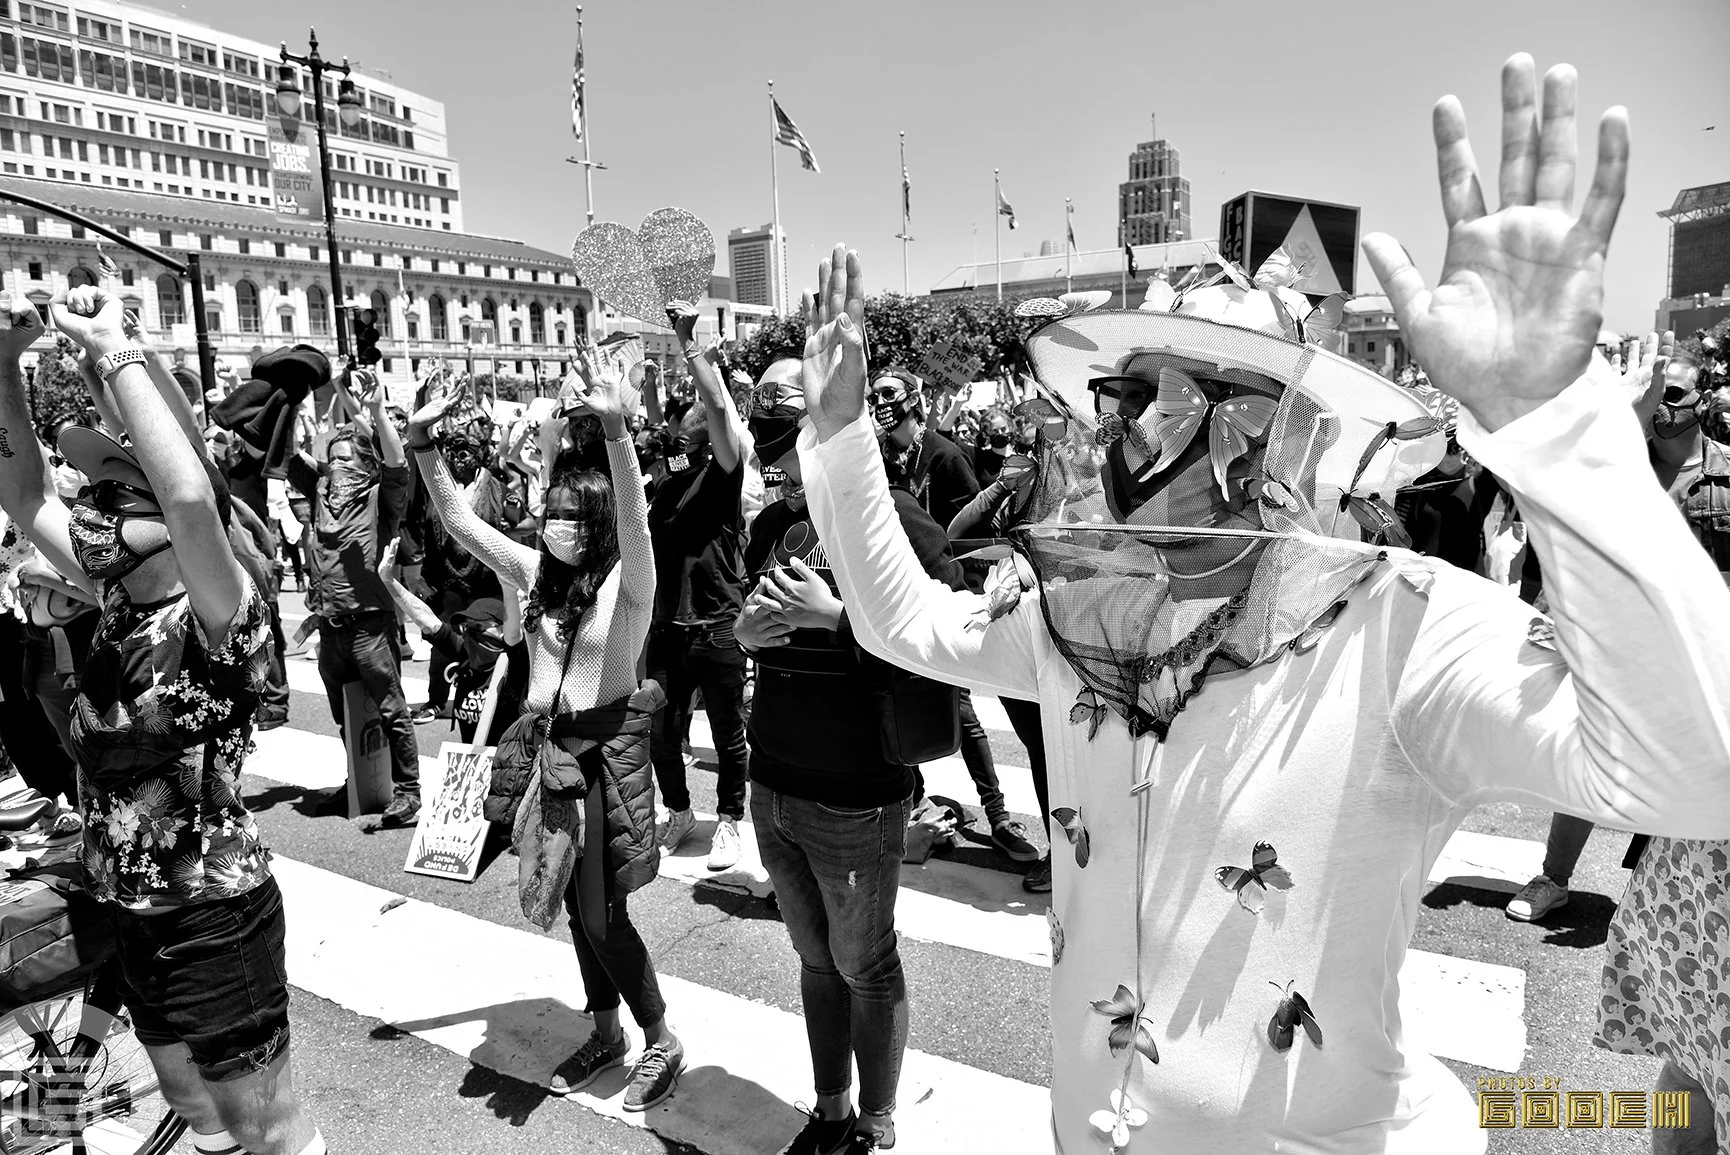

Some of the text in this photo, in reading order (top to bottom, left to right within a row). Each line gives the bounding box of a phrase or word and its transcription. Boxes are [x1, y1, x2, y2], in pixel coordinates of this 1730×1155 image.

[270, 141, 310, 158] CREATING
[272, 153, 311, 173] JOBS.
[275, 178, 292, 190] OUR
[1223, 203, 1234, 265] FIG
[1232, 205, 1244, 262] BAC
[931, 351, 951, 365] THE
[951, 362, 970, 377] WAR
[946, 347, 968, 364] END
[461, 698, 485, 711] LOV
[454, 708, 482, 724] ADJU
[424, 860, 460, 873] DEFUND
